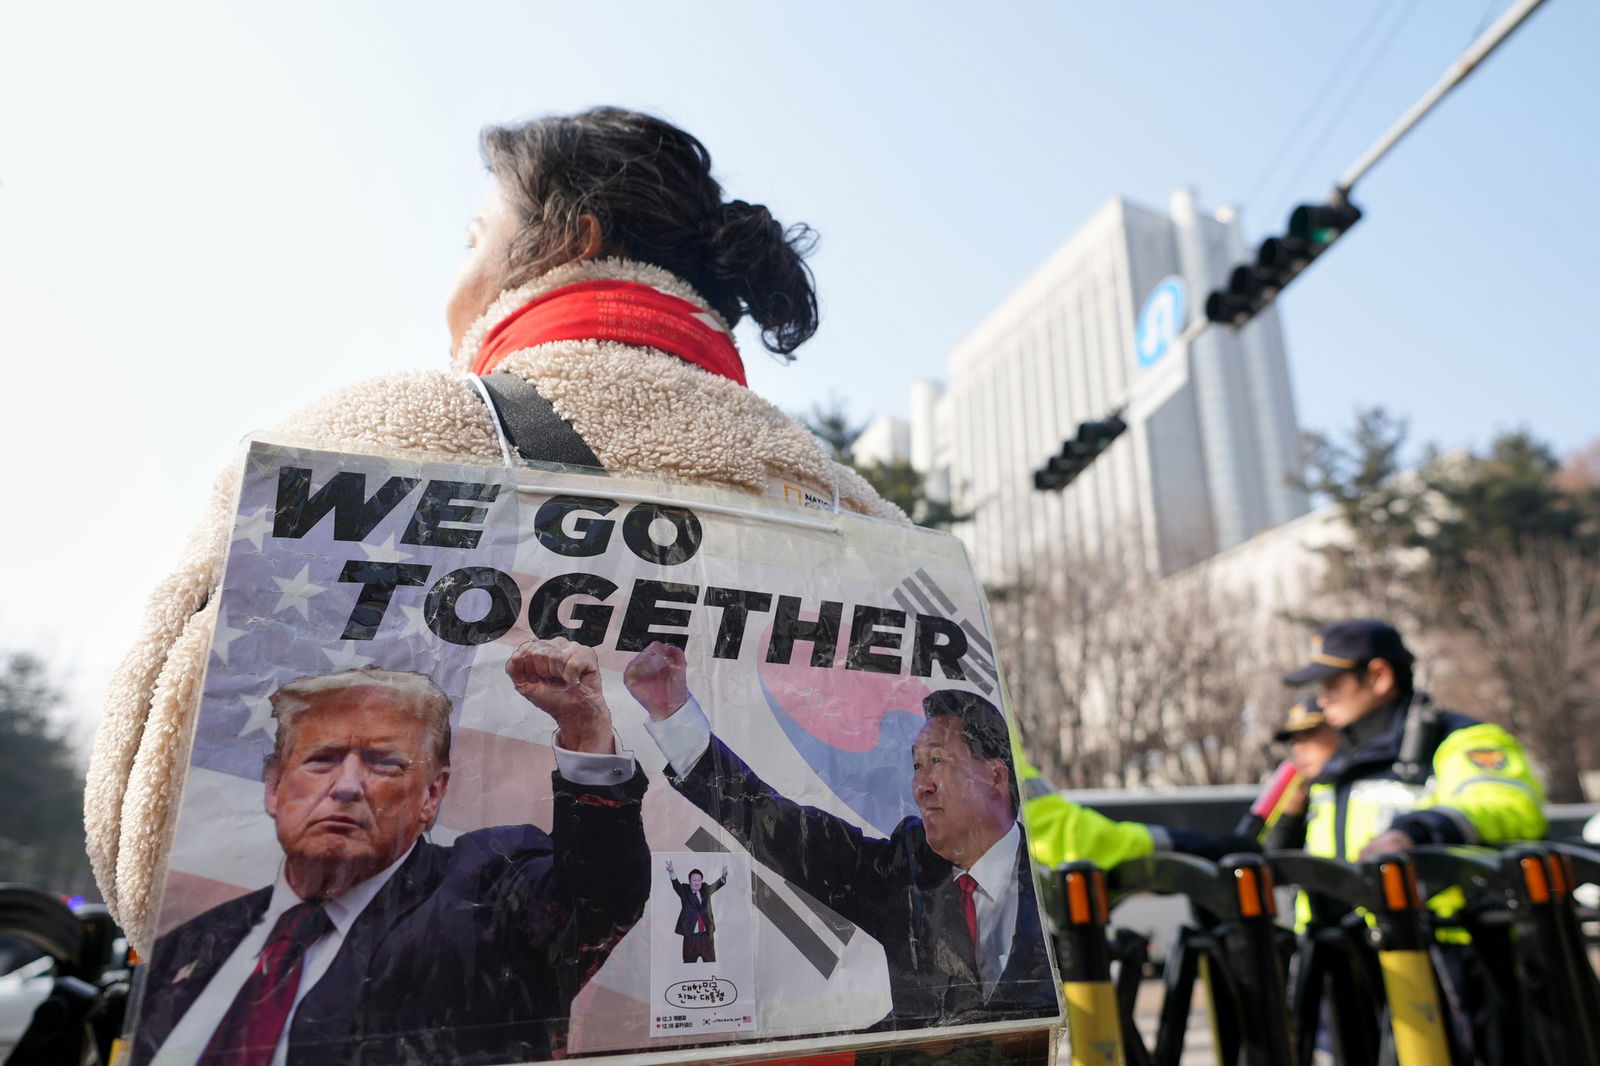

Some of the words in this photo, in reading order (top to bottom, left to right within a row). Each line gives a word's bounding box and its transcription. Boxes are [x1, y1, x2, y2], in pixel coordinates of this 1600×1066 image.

[271, 466, 500, 550] WE
[533, 496, 703, 566] GO
[336, 560, 969, 681] TOGETHER
[677, 993, 697, 1003] 진짜
[699, 991, 725, 1003] 대통령
[681, 982, 718, 993] 대한민국
